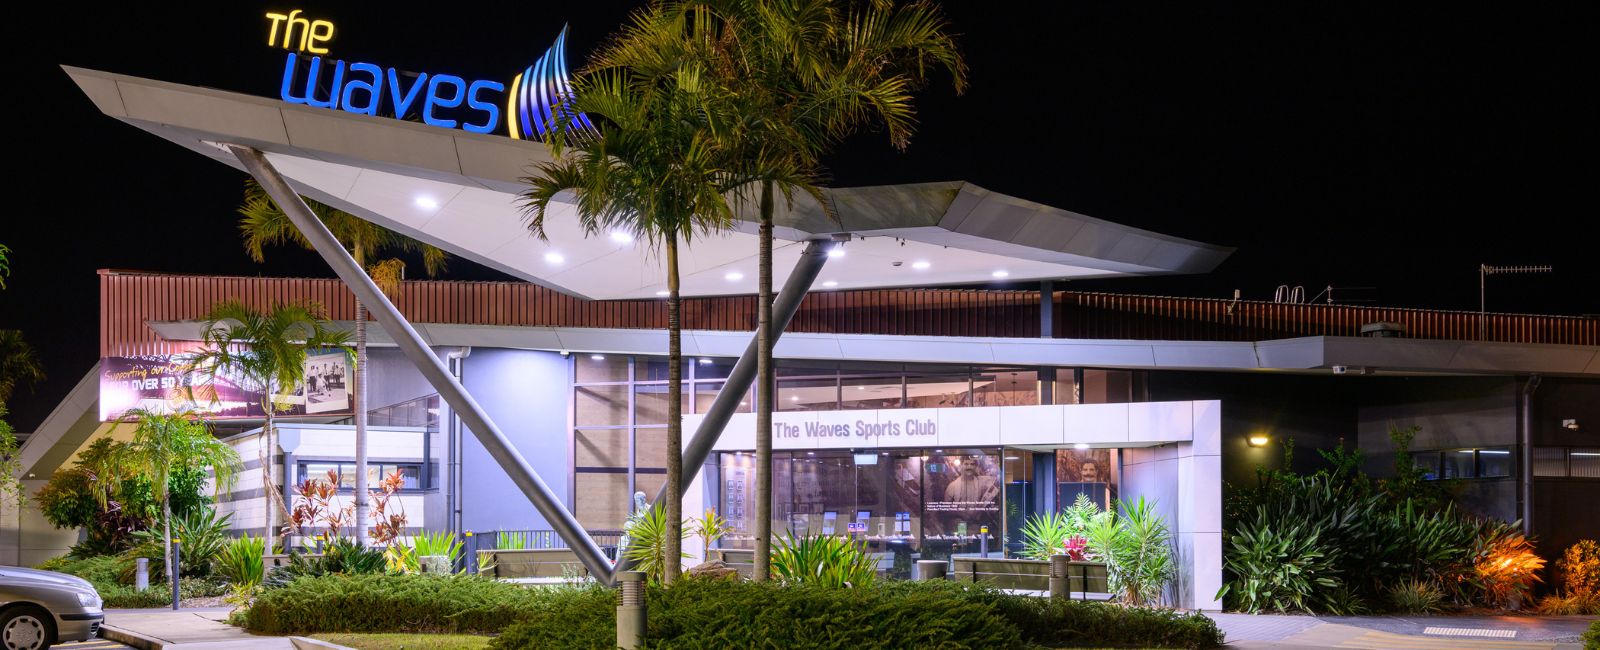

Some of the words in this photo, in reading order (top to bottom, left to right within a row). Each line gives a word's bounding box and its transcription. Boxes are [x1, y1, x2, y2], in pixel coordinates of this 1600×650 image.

[266, 10, 334, 54] The
[281, 53, 504, 134] waves
[104, 366, 147, 382] Supporting
[132, 378, 158, 391] OVER
[161, 376, 176, 389] 50
[774, 422, 800, 438] The
[805, 421, 850, 438] Waves
[855, 420, 900, 440] Sports
[905, 419, 936, 436] Club
